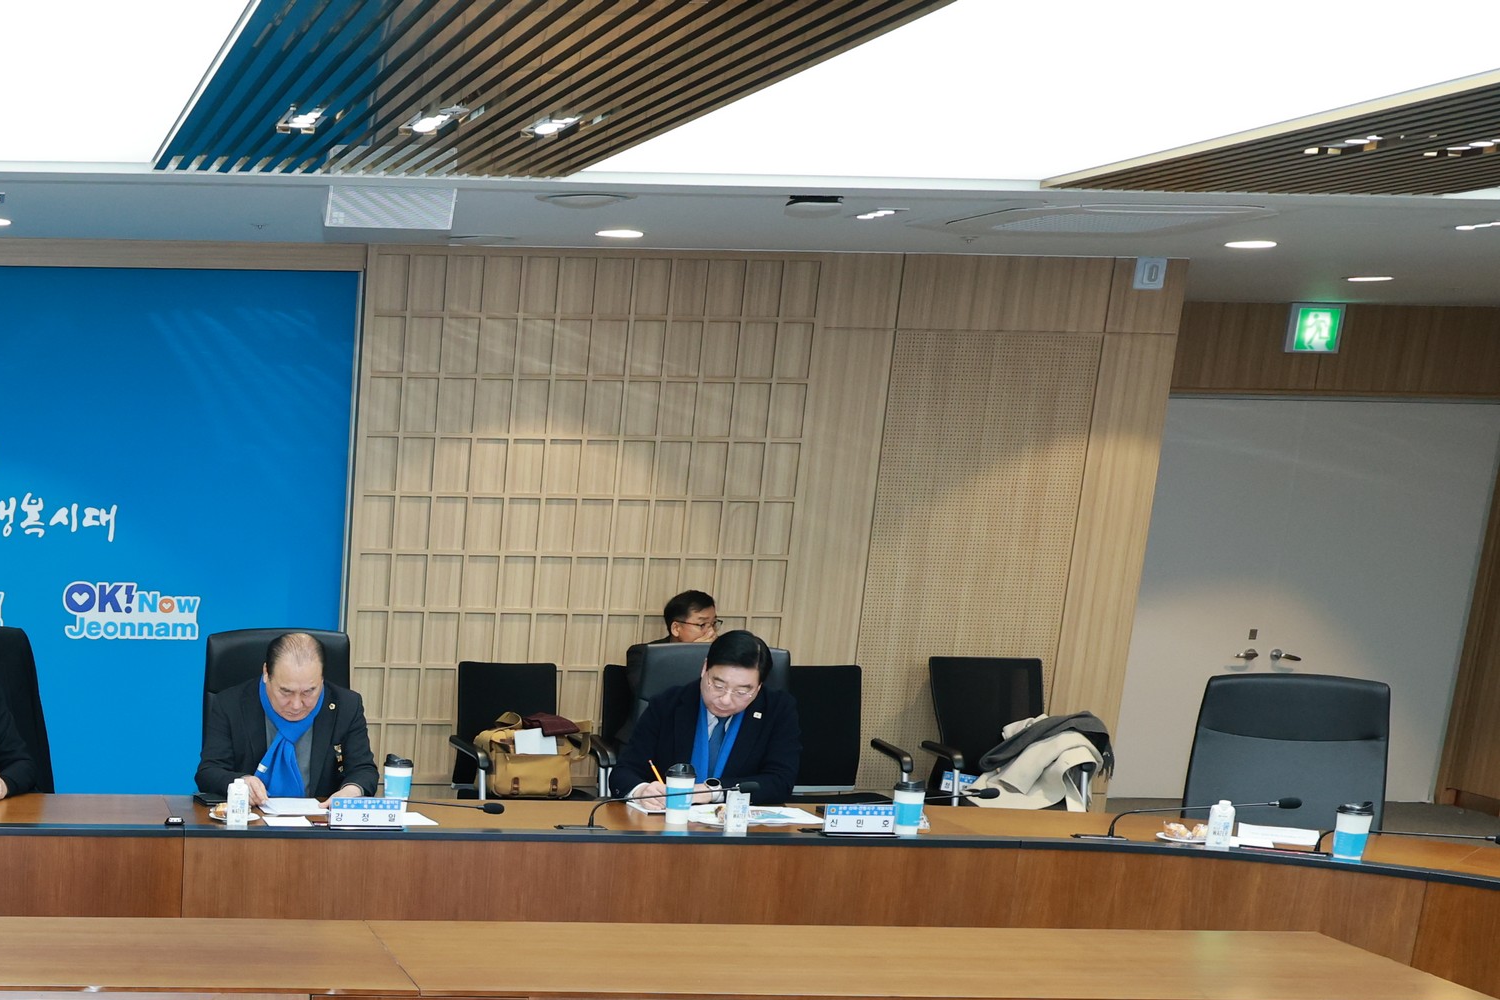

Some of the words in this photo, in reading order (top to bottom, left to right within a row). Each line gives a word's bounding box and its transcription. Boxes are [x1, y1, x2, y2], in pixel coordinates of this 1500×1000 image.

[65, 583, 136, 614] OK!
[139, 593, 198, 613] Now
[66, 617, 197, 637] Jeonnam
[336, 813, 342, 821] 강
[362, 813, 369, 821] 정
[388, 814, 395, 822] 일
[831, 819, 838, 827] 신
[856, 819, 863, 827] 민
